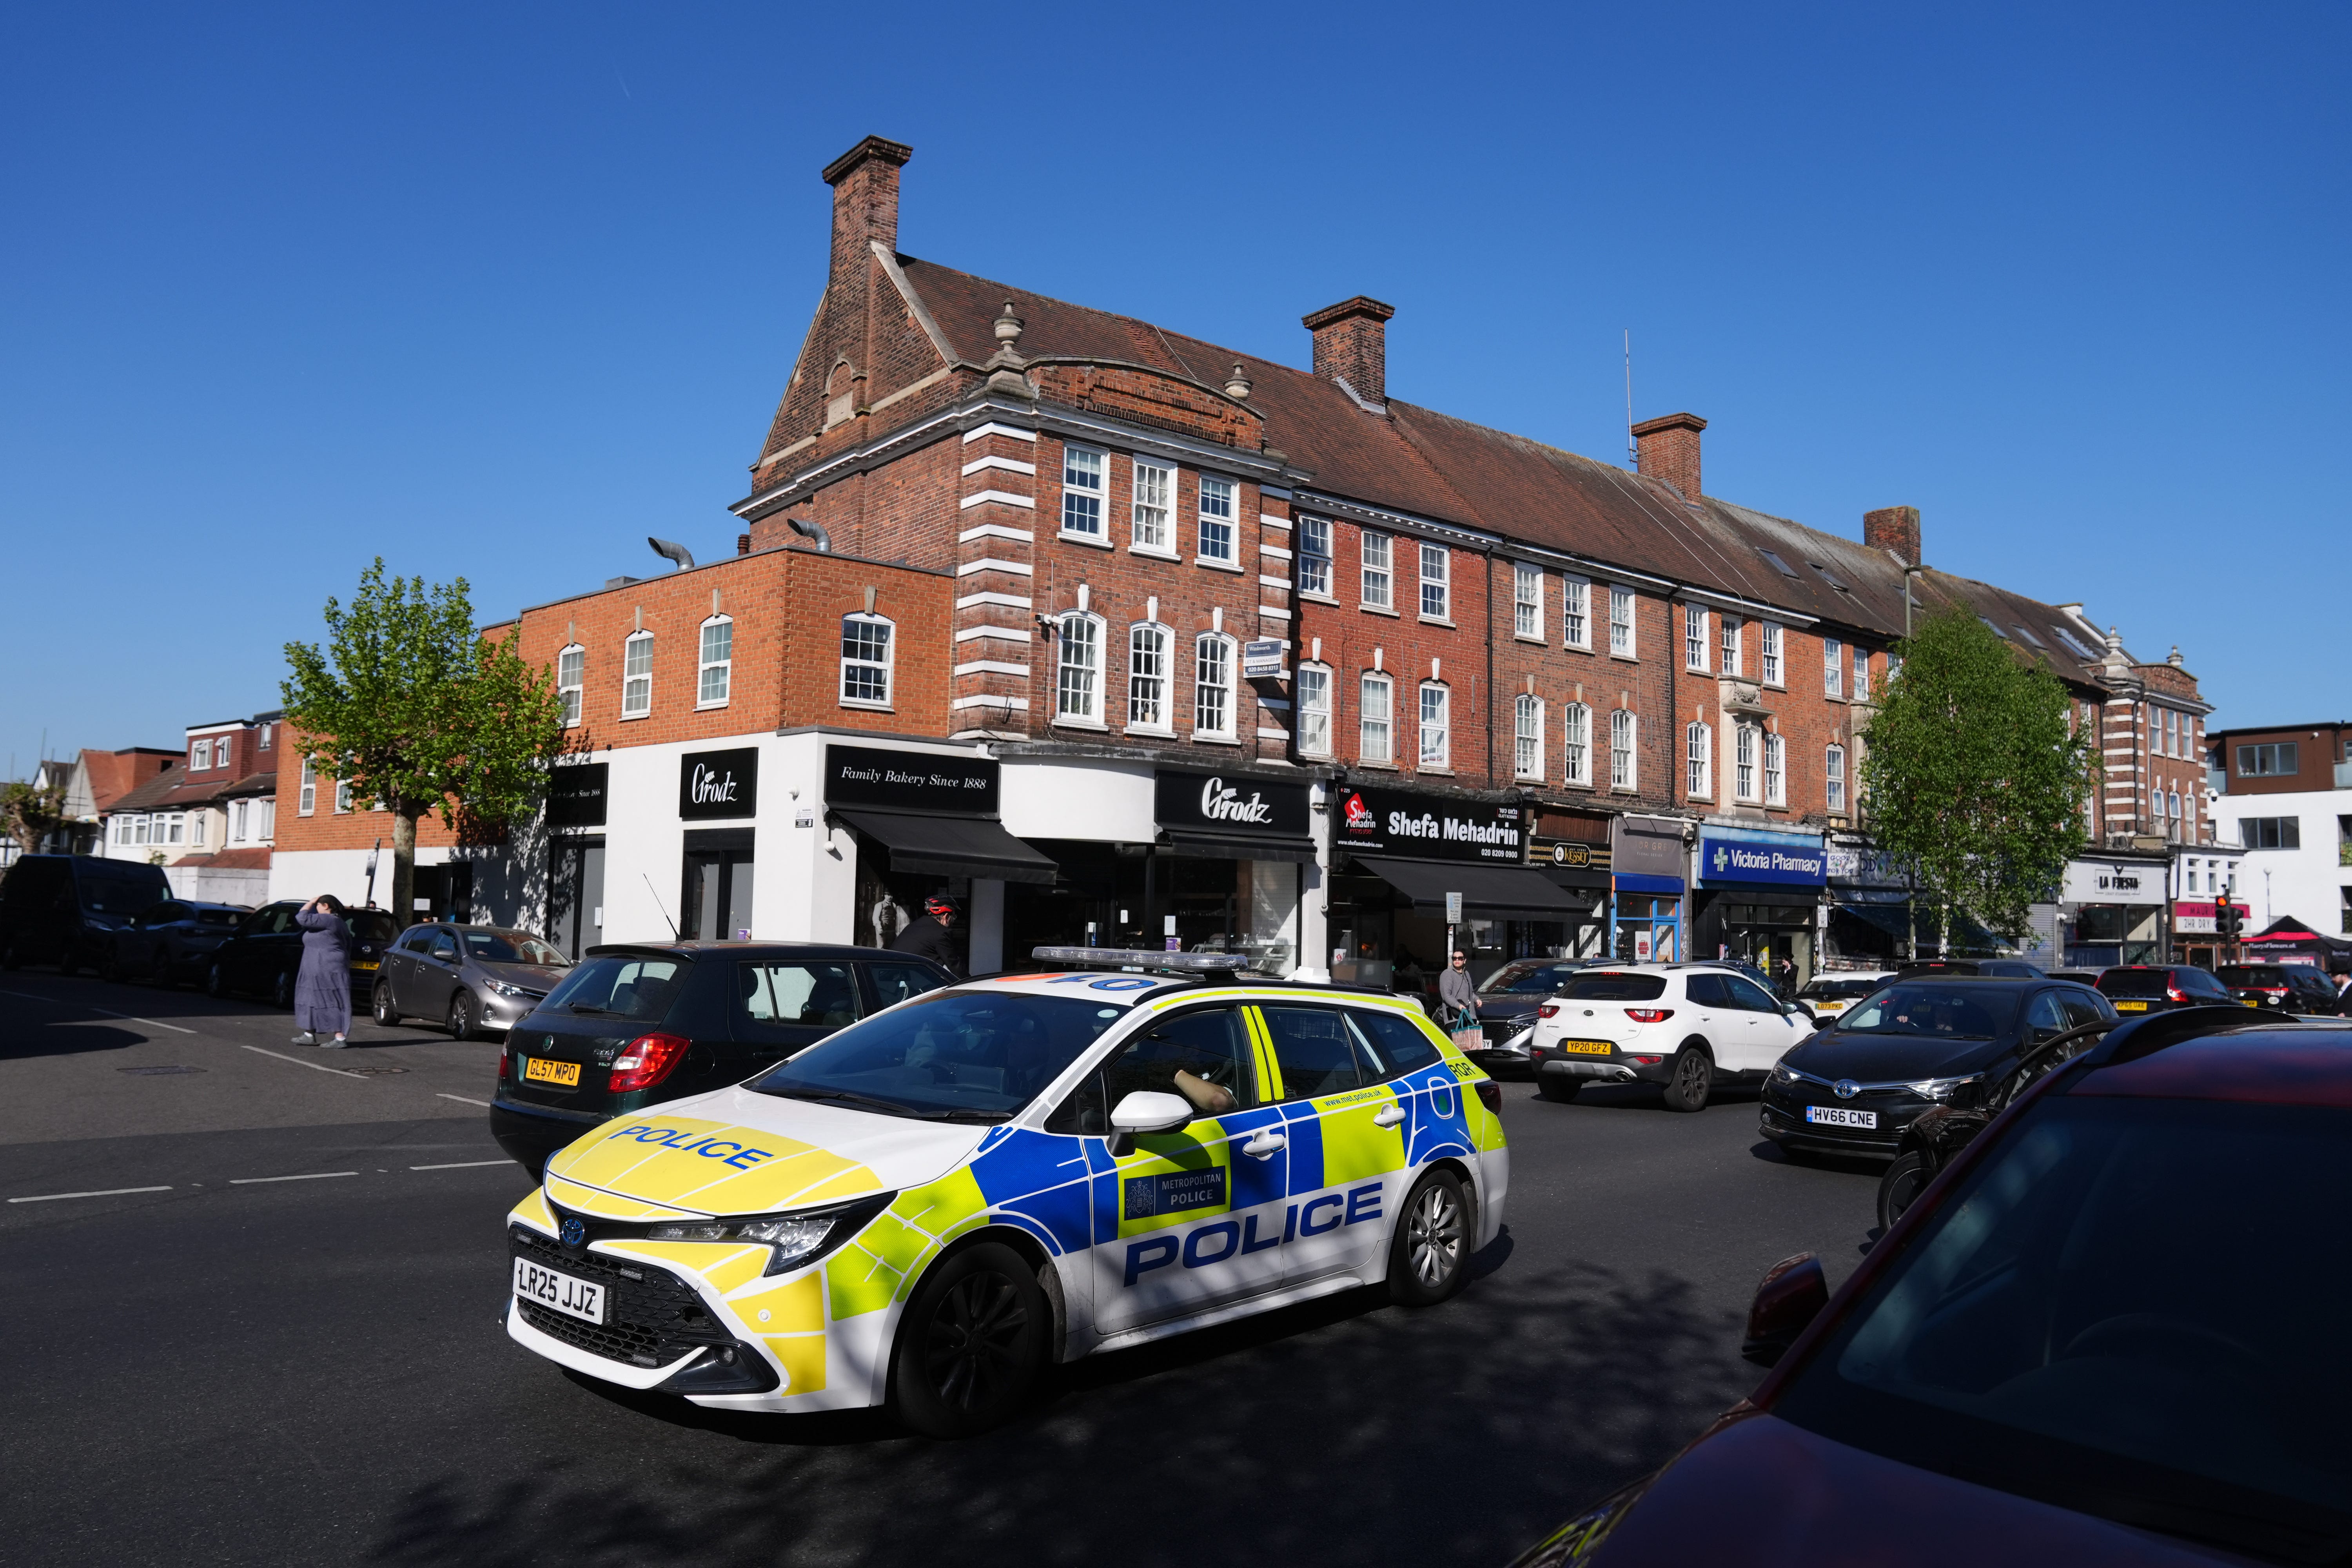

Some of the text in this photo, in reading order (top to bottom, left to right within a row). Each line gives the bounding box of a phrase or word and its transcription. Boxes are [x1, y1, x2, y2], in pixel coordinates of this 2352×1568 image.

[692, 763, 738, 804] Grodz
[841, 766, 986, 789] Family Bakery Since 1888
[1201, 777, 1272, 824] Grodz
[1350, 800, 1372, 819] Shefa
[1345, 818, 1376, 828] Mehadrin
[1388, 811, 1439, 838] Shefa
[1443, 817, 1518, 846] Mehadrin
[1338, 840, 1383, 848] www.shefamehadrin.com
[1492, 849, 1504, 857] 8209
[1505, 850, 1518, 858] 0900
[1731, 849, 1821, 877] Victoria Pharmacy
[2099, 876, 2109, 889] LA
[2184, 918, 2195, 928] 2HR
[2198, 919, 2210, 928] DRY
[1570, 1042, 1608, 1053] YP20 GFZ
[530, 1060, 576, 1081] GL57 MPO
[1450, 1063, 1476, 1078] RQR
[1323, 1089, 1383, 1107] www.met.police.uk
[1815, 1108, 1873, 1125] HV66 CNE
[607, 1126, 775, 1171] POLICE
[1161, 1173, 1221, 1191] METROPOLITAN
[1171, 1189, 1213, 1205] POLICE
[1123, 1181, 1383, 1288] POLICE
[518, 1263, 596, 1316] LR25 JJZ
